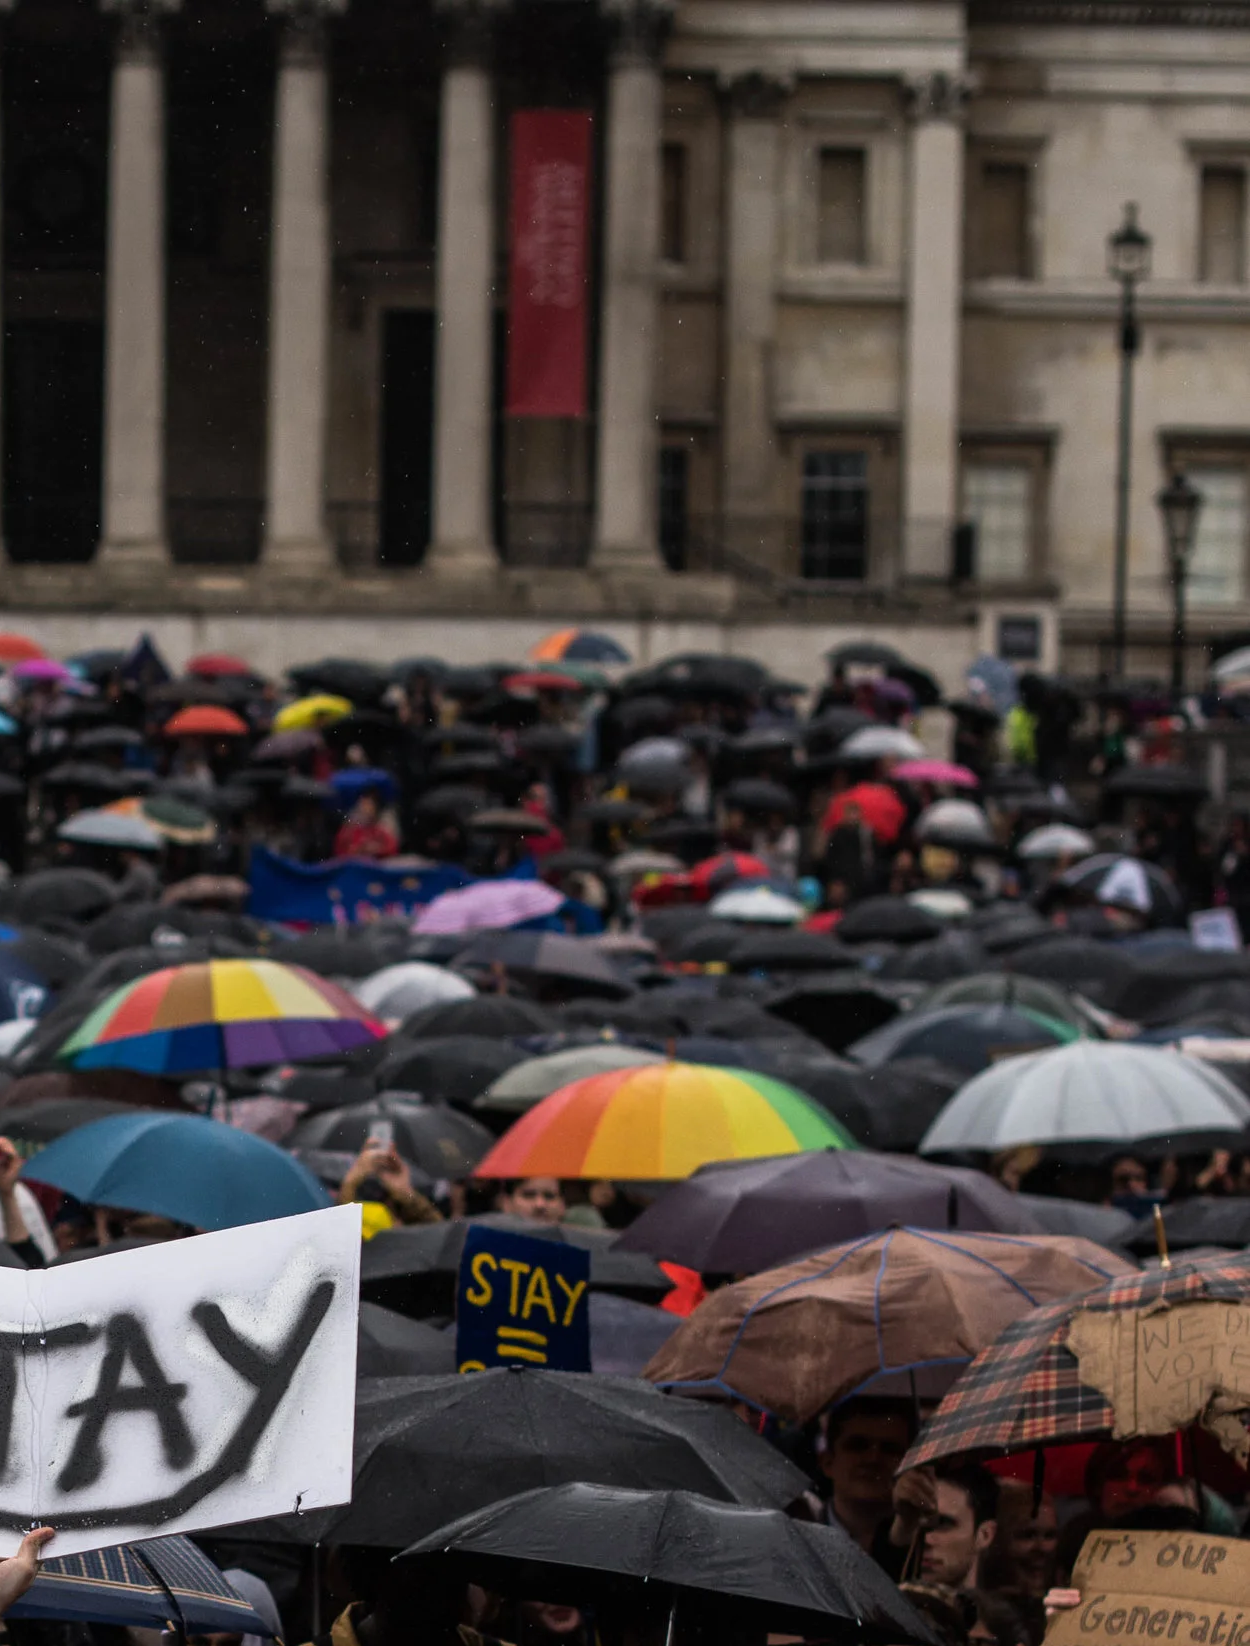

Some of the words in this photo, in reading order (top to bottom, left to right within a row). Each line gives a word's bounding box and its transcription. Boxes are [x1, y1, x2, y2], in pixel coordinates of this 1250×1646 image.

[466, 1252, 587, 1327] STAY
[1142, 1316, 1206, 1354] WE
[1086, 1535, 1137, 1567] IT'S
[1156, 1543, 1228, 1575] OUR
